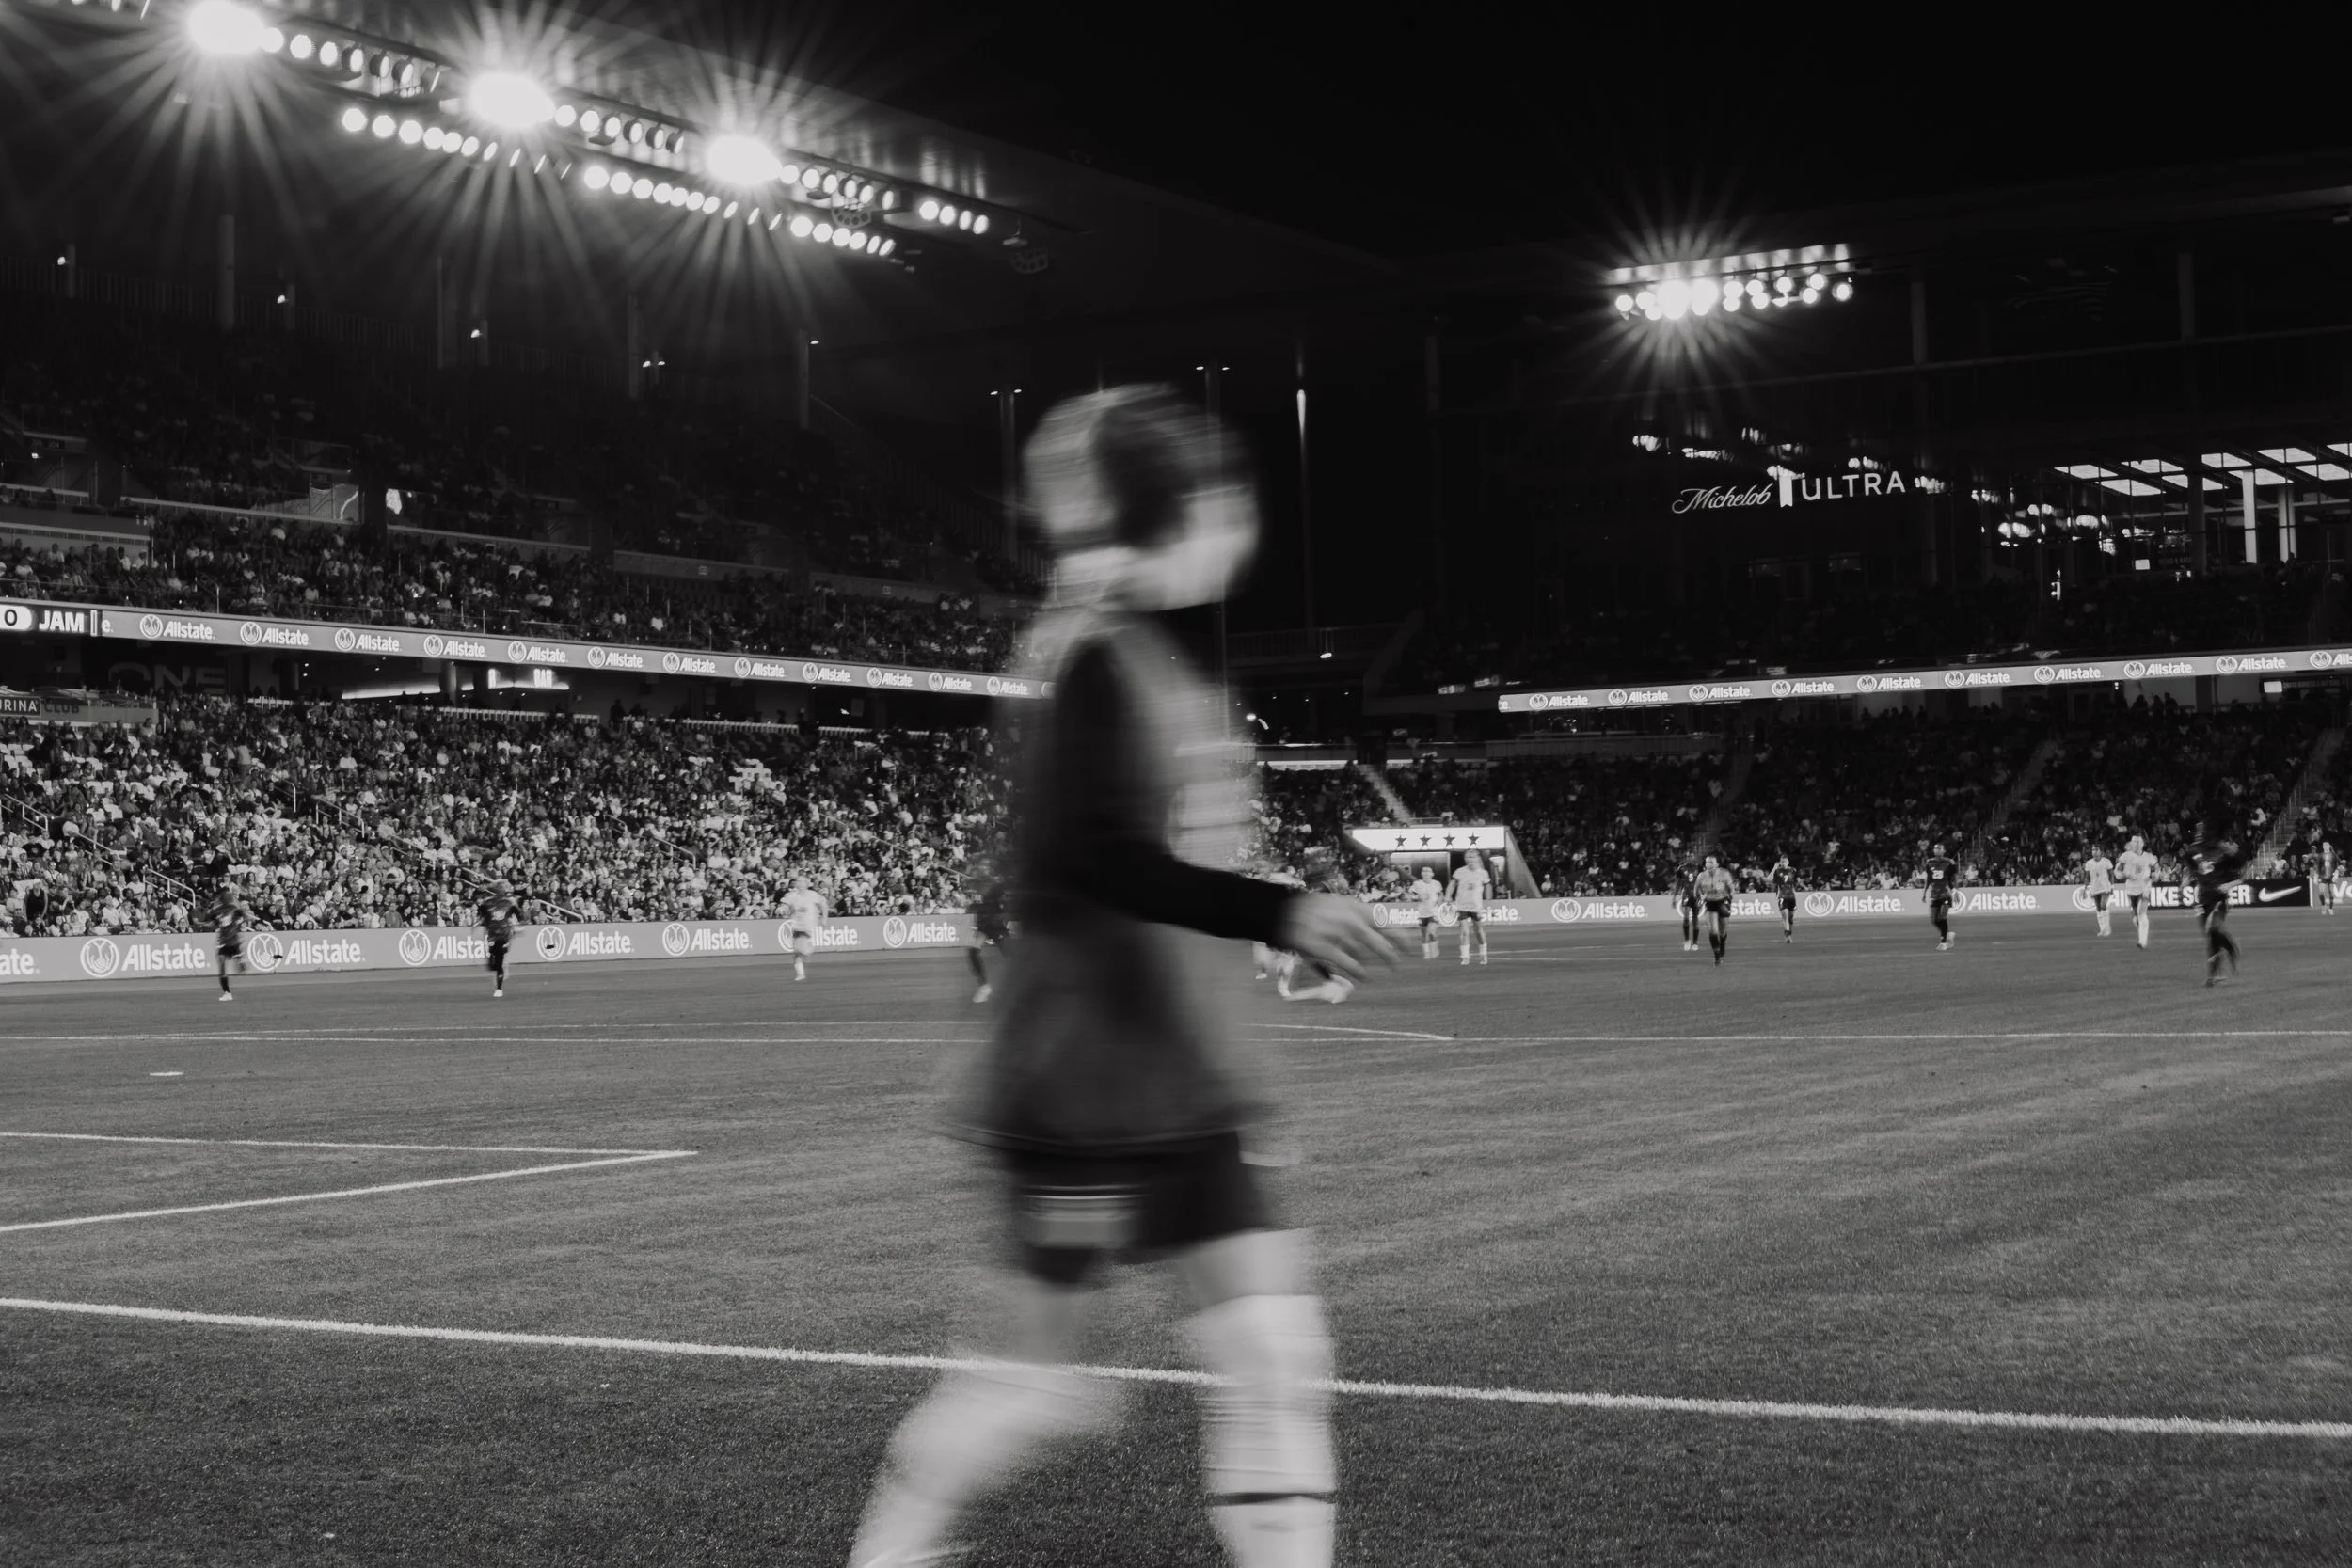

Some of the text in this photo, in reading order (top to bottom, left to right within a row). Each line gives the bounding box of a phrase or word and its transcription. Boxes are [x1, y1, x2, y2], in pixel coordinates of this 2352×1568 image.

[1672, 470, 1906, 514] Michelob ULTRA
[39, 610, 85, 633] JAM
